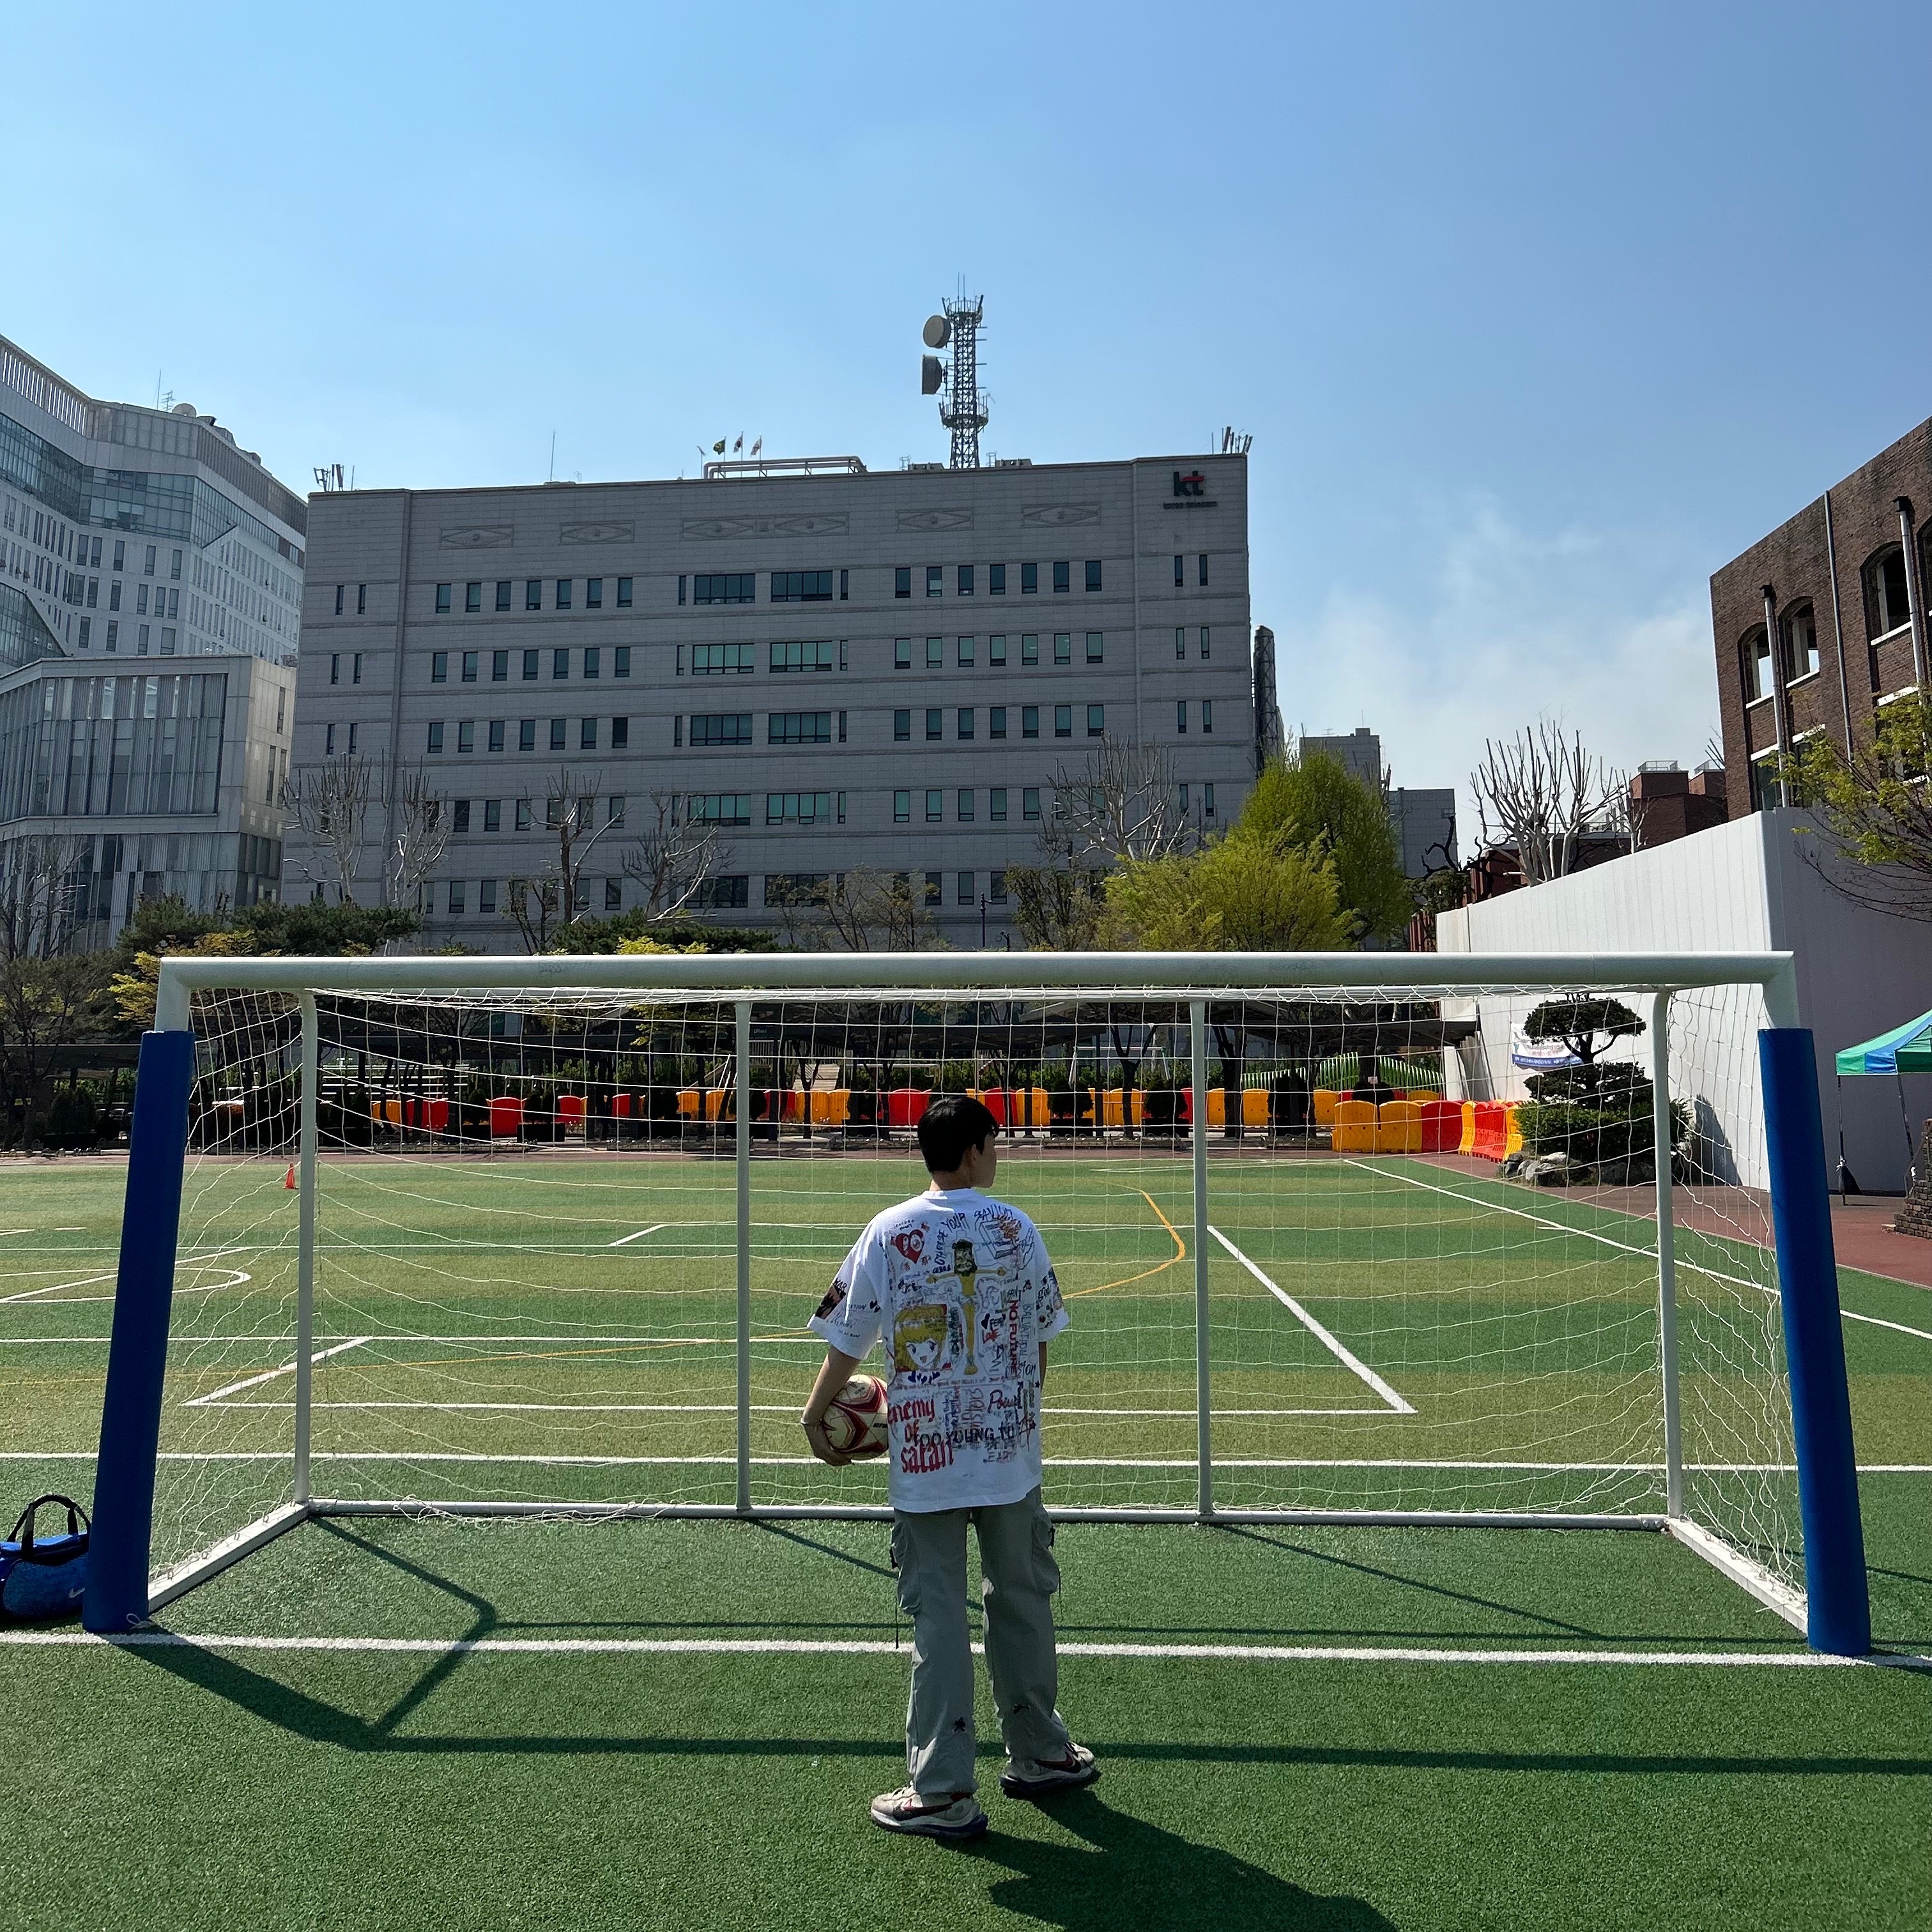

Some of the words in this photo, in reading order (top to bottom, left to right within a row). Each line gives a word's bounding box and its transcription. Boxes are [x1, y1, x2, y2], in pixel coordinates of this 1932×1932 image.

[1173, 470, 1205, 496] kt
[940, 1213, 970, 1234] YOUR
[1008, 1300, 1019, 1321] NO
[1008, 1323, 1019, 1376] FUTURE
[946, 1427, 995, 1444] YOUNG
[901, 1438, 954, 1474] satan
